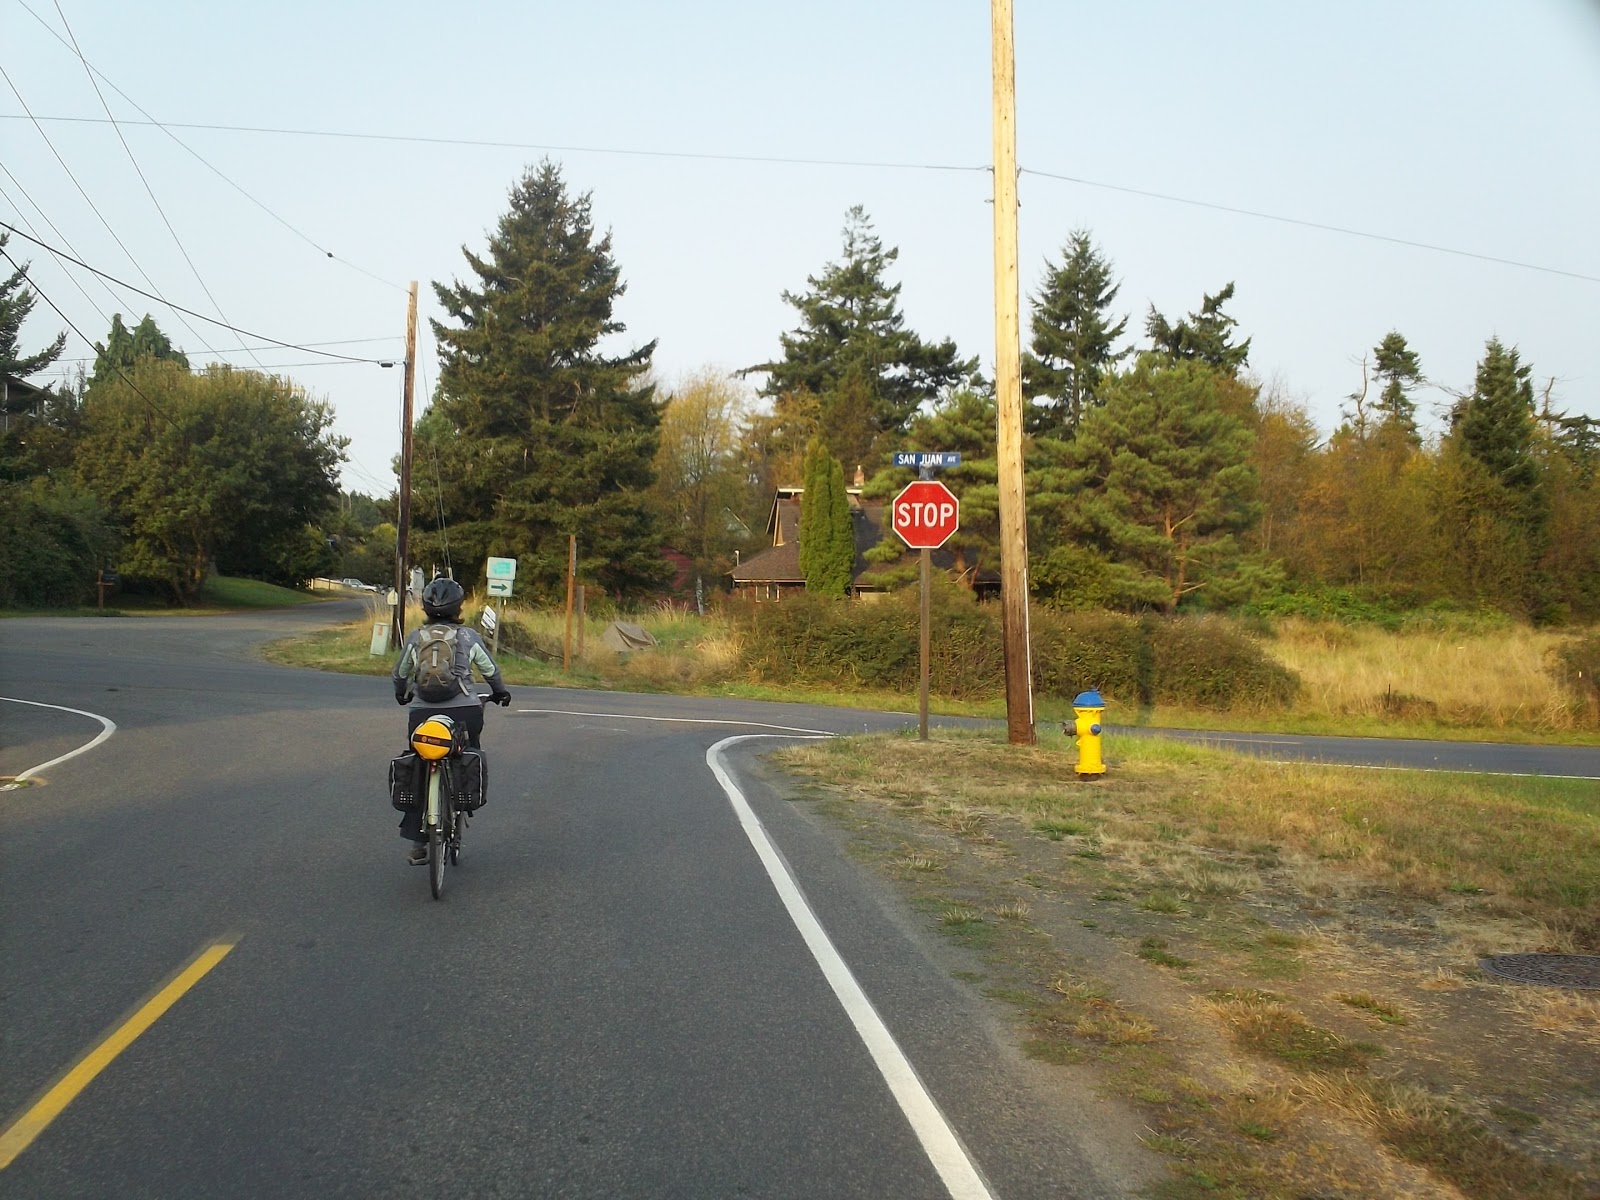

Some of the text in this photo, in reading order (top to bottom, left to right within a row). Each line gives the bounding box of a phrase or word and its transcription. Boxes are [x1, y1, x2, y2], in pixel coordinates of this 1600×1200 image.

[898, 454, 915, 464] SAN
[919, 454, 942, 464] JUAN
[897, 502, 954, 527] STOP
